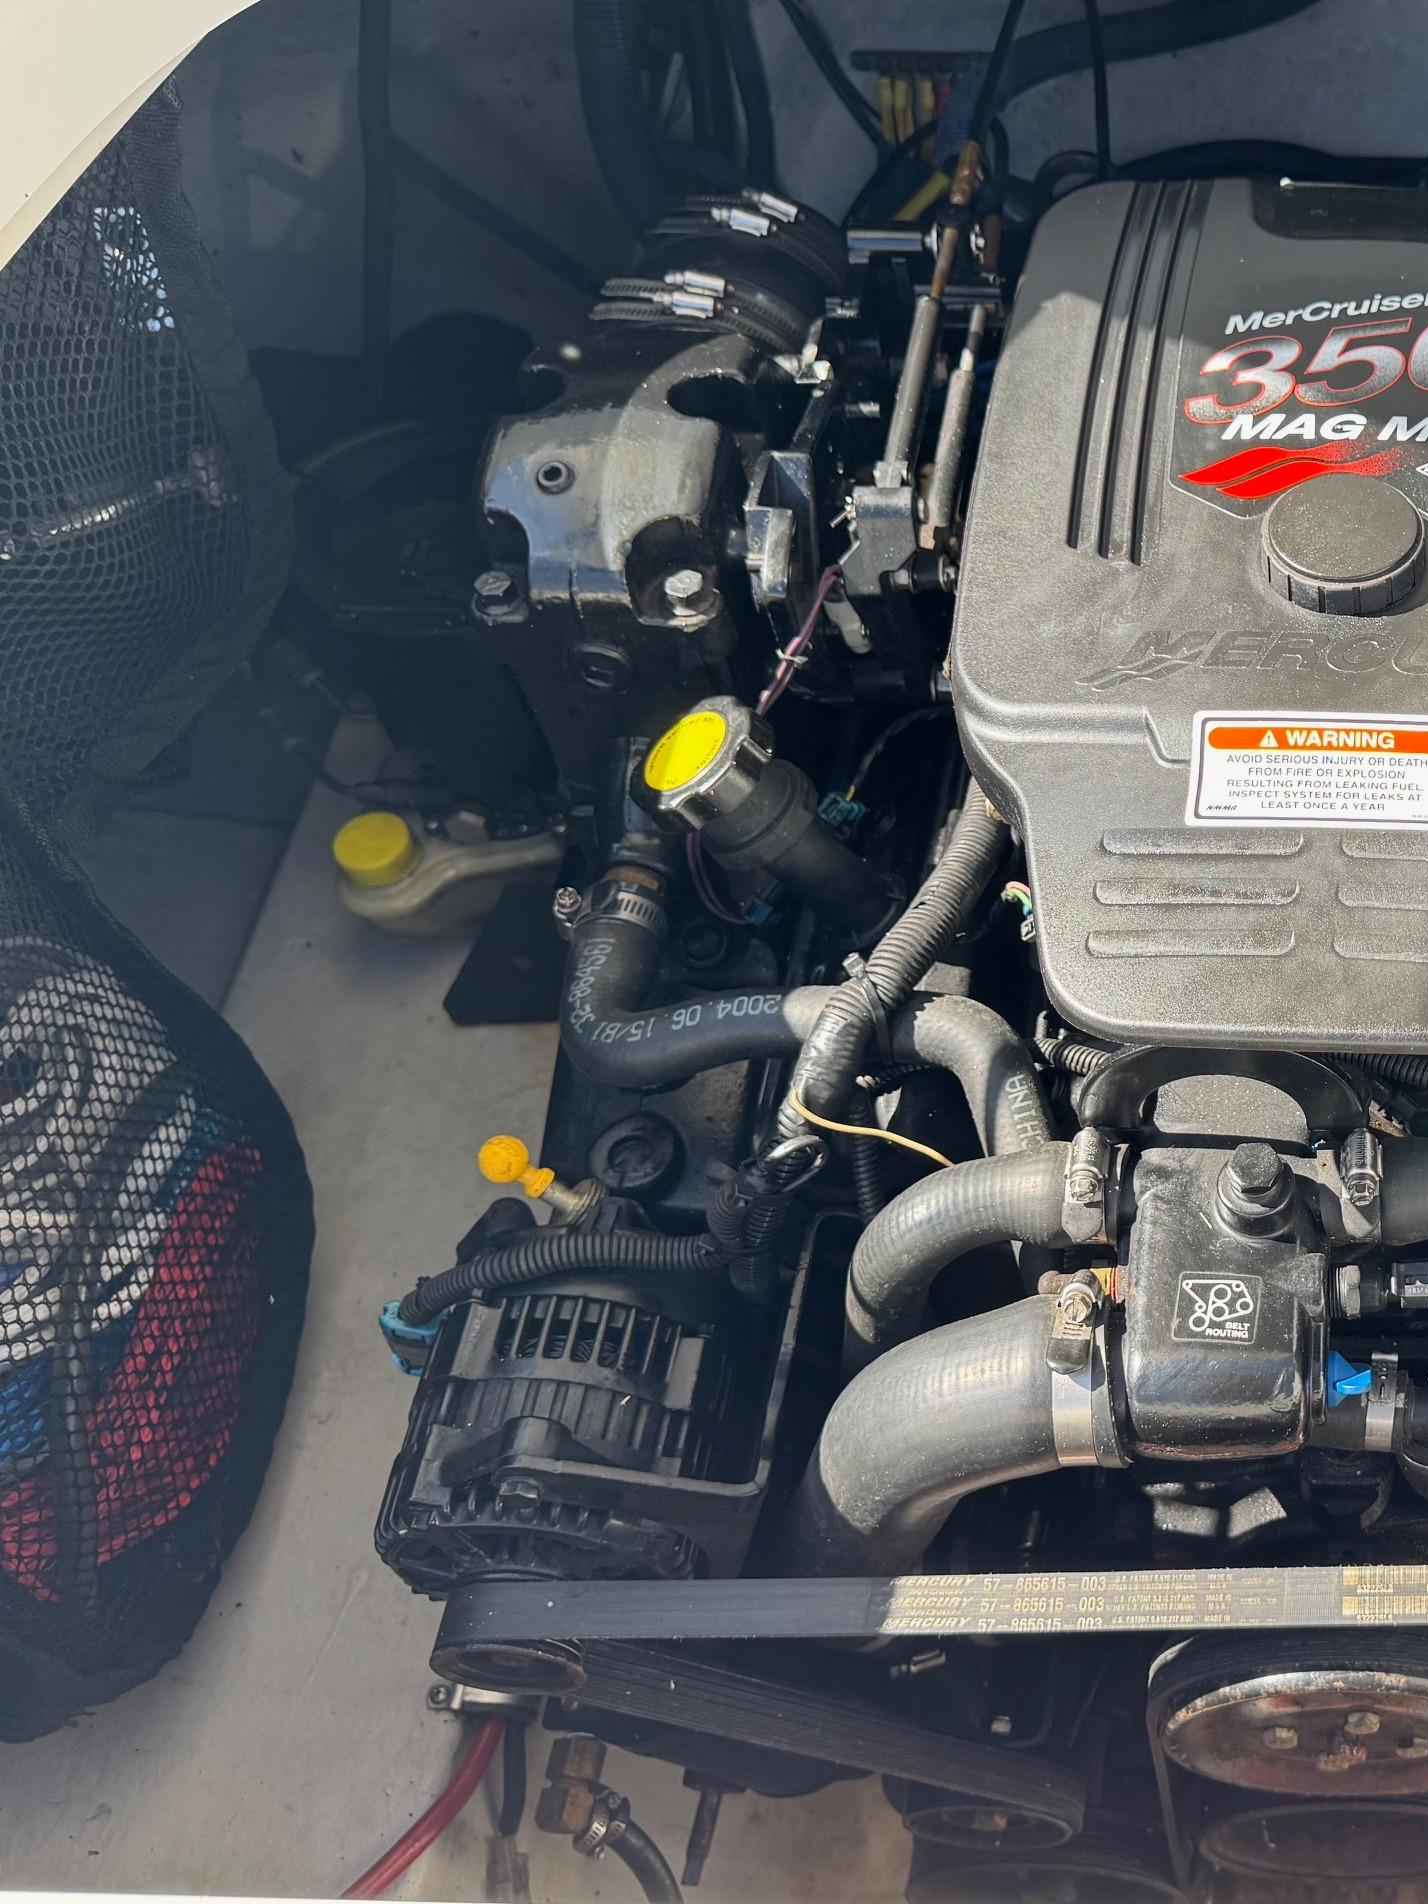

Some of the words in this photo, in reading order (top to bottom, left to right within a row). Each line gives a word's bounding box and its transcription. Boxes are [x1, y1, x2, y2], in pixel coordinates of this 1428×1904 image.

[1220, 412, 1368, 441] MAG
[1285, 729, 1395, 749] WARNING
[1226, 754, 1263, 764] AVOID
[1266, 755, 1319, 765] SERIOUS
[1321, 756, 1364, 766] INJURY
[1368, 757, 1386, 766] OR
[1388, 758, 1428, 768] DEATH
[1248, 767, 1283, 776] FROM
[1286, 768, 1312, 777] FIRE
[1316, 768, 1333, 777] OR
[1337, 769, 1406, 779] EXPLOSION
[1226, 779, 1294, 788] RESULTING
[1297, 780, 1332, 788] FROM
[1335, 781, 1388, 790] LEAKING
[1228, 790, 1279, 798] INSPECT
[1283, 791, 1332, 799] SYSTEM
[1335, 791, 1360, 800] FOR
[1364, 793, 1403, 801] LEAKS
[1407, 793, 1421, 801] AT
[1260, 801, 1300, 809] LEAST
[1303, 802, 1337, 810] ONCE
[1352, 803, 1386, 812] YEAR
[1225, 1321, 1251, 1331] BELT
[1205, 1328, 1249, 1339] ROUTING
[879, 1616, 973, 1631] MERCURY
